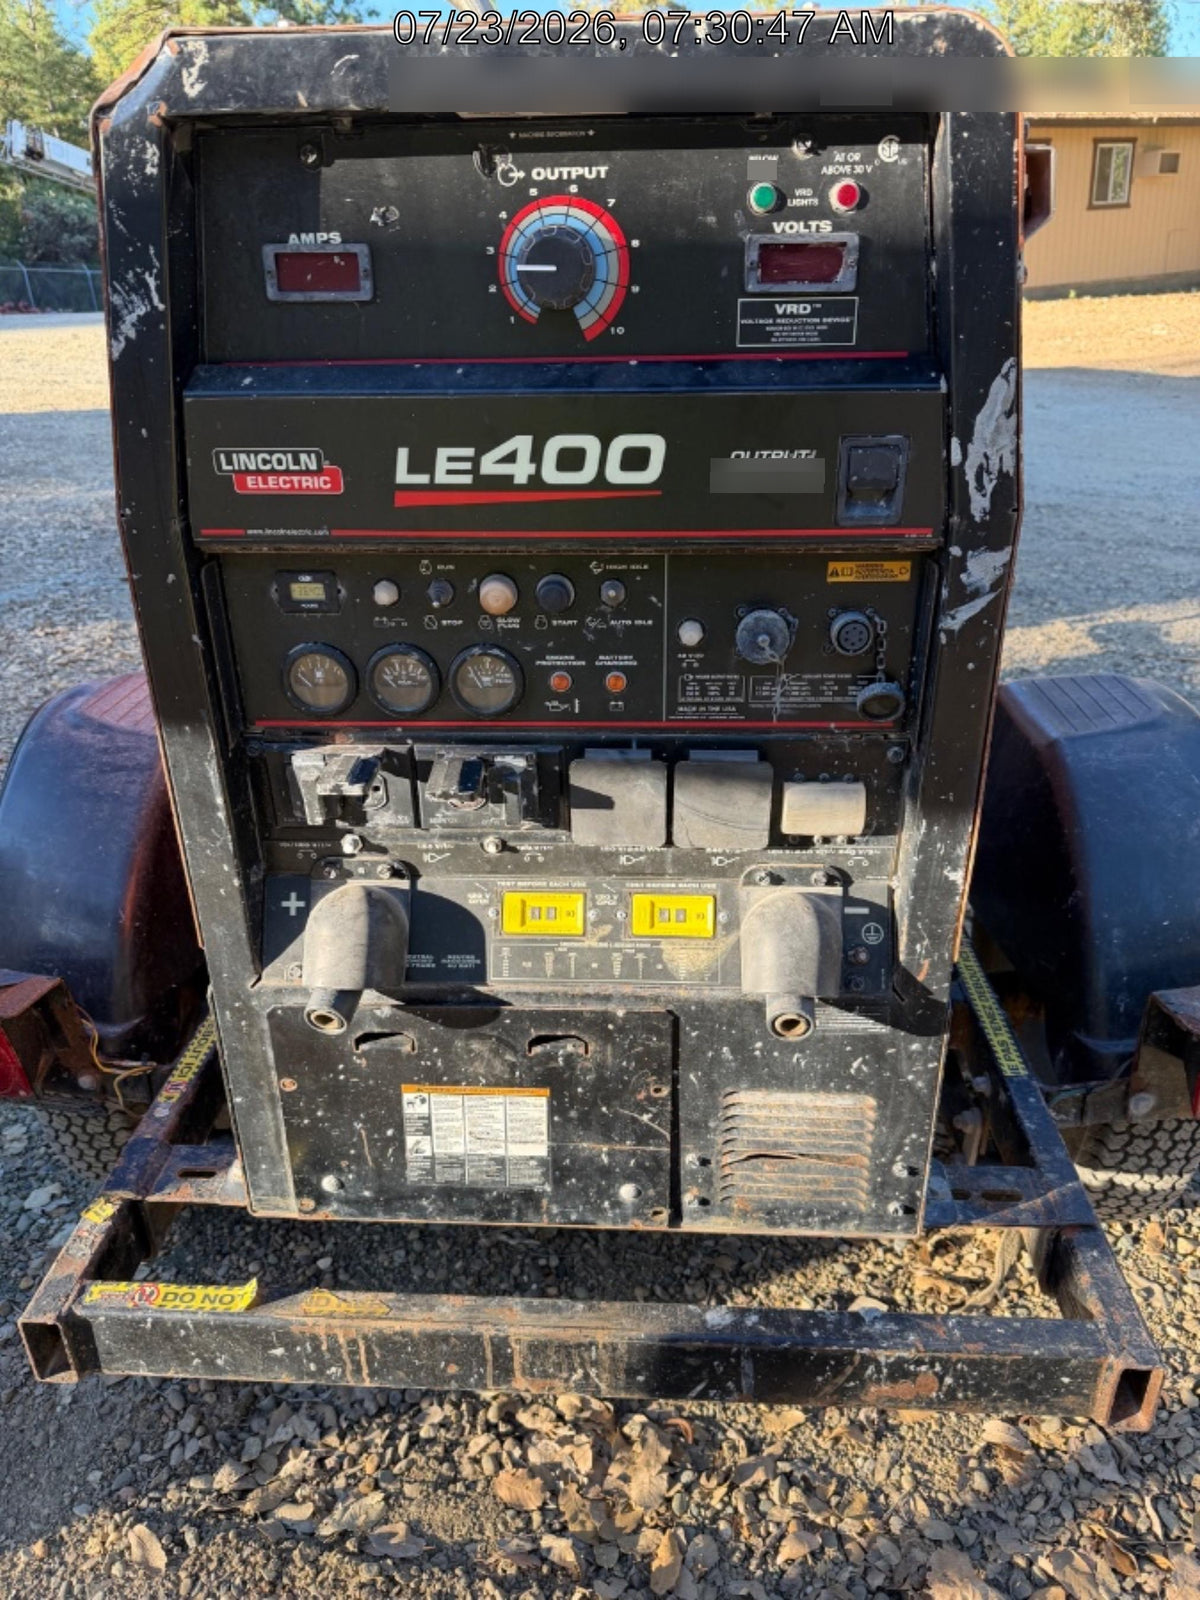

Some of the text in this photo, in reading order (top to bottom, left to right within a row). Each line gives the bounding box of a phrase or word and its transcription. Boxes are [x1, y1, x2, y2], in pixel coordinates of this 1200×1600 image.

[531, 166, 609, 181] OUTPUT
[820, 165, 874, 175] ABOVE 30 V
[529, 188, 538, 196] 5
[570, 185, 578, 193] 6
[794, 188, 814, 196] VRD
[607, 198, 616, 207] 7
[787, 198, 819, 207] LIGHTS
[499, 211, 508, 220] 4
[772, 220, 833, 234] VOLTS
[288, 232, 342, 245] AMPS
[631, 240, 640, 248] 8
[486, 246, 494, 254] 3
[488, 284, 497, 292] 2
[632, 285, 640, 293] 9
[610, 326, 625, 335] 10
[219, 453, 318, 472] LINCOLN
[394, 434, 667, 486] LE400
[246, 476, 332, 490] ELECTRIC
[162, 1292, 196, 1304] DO
